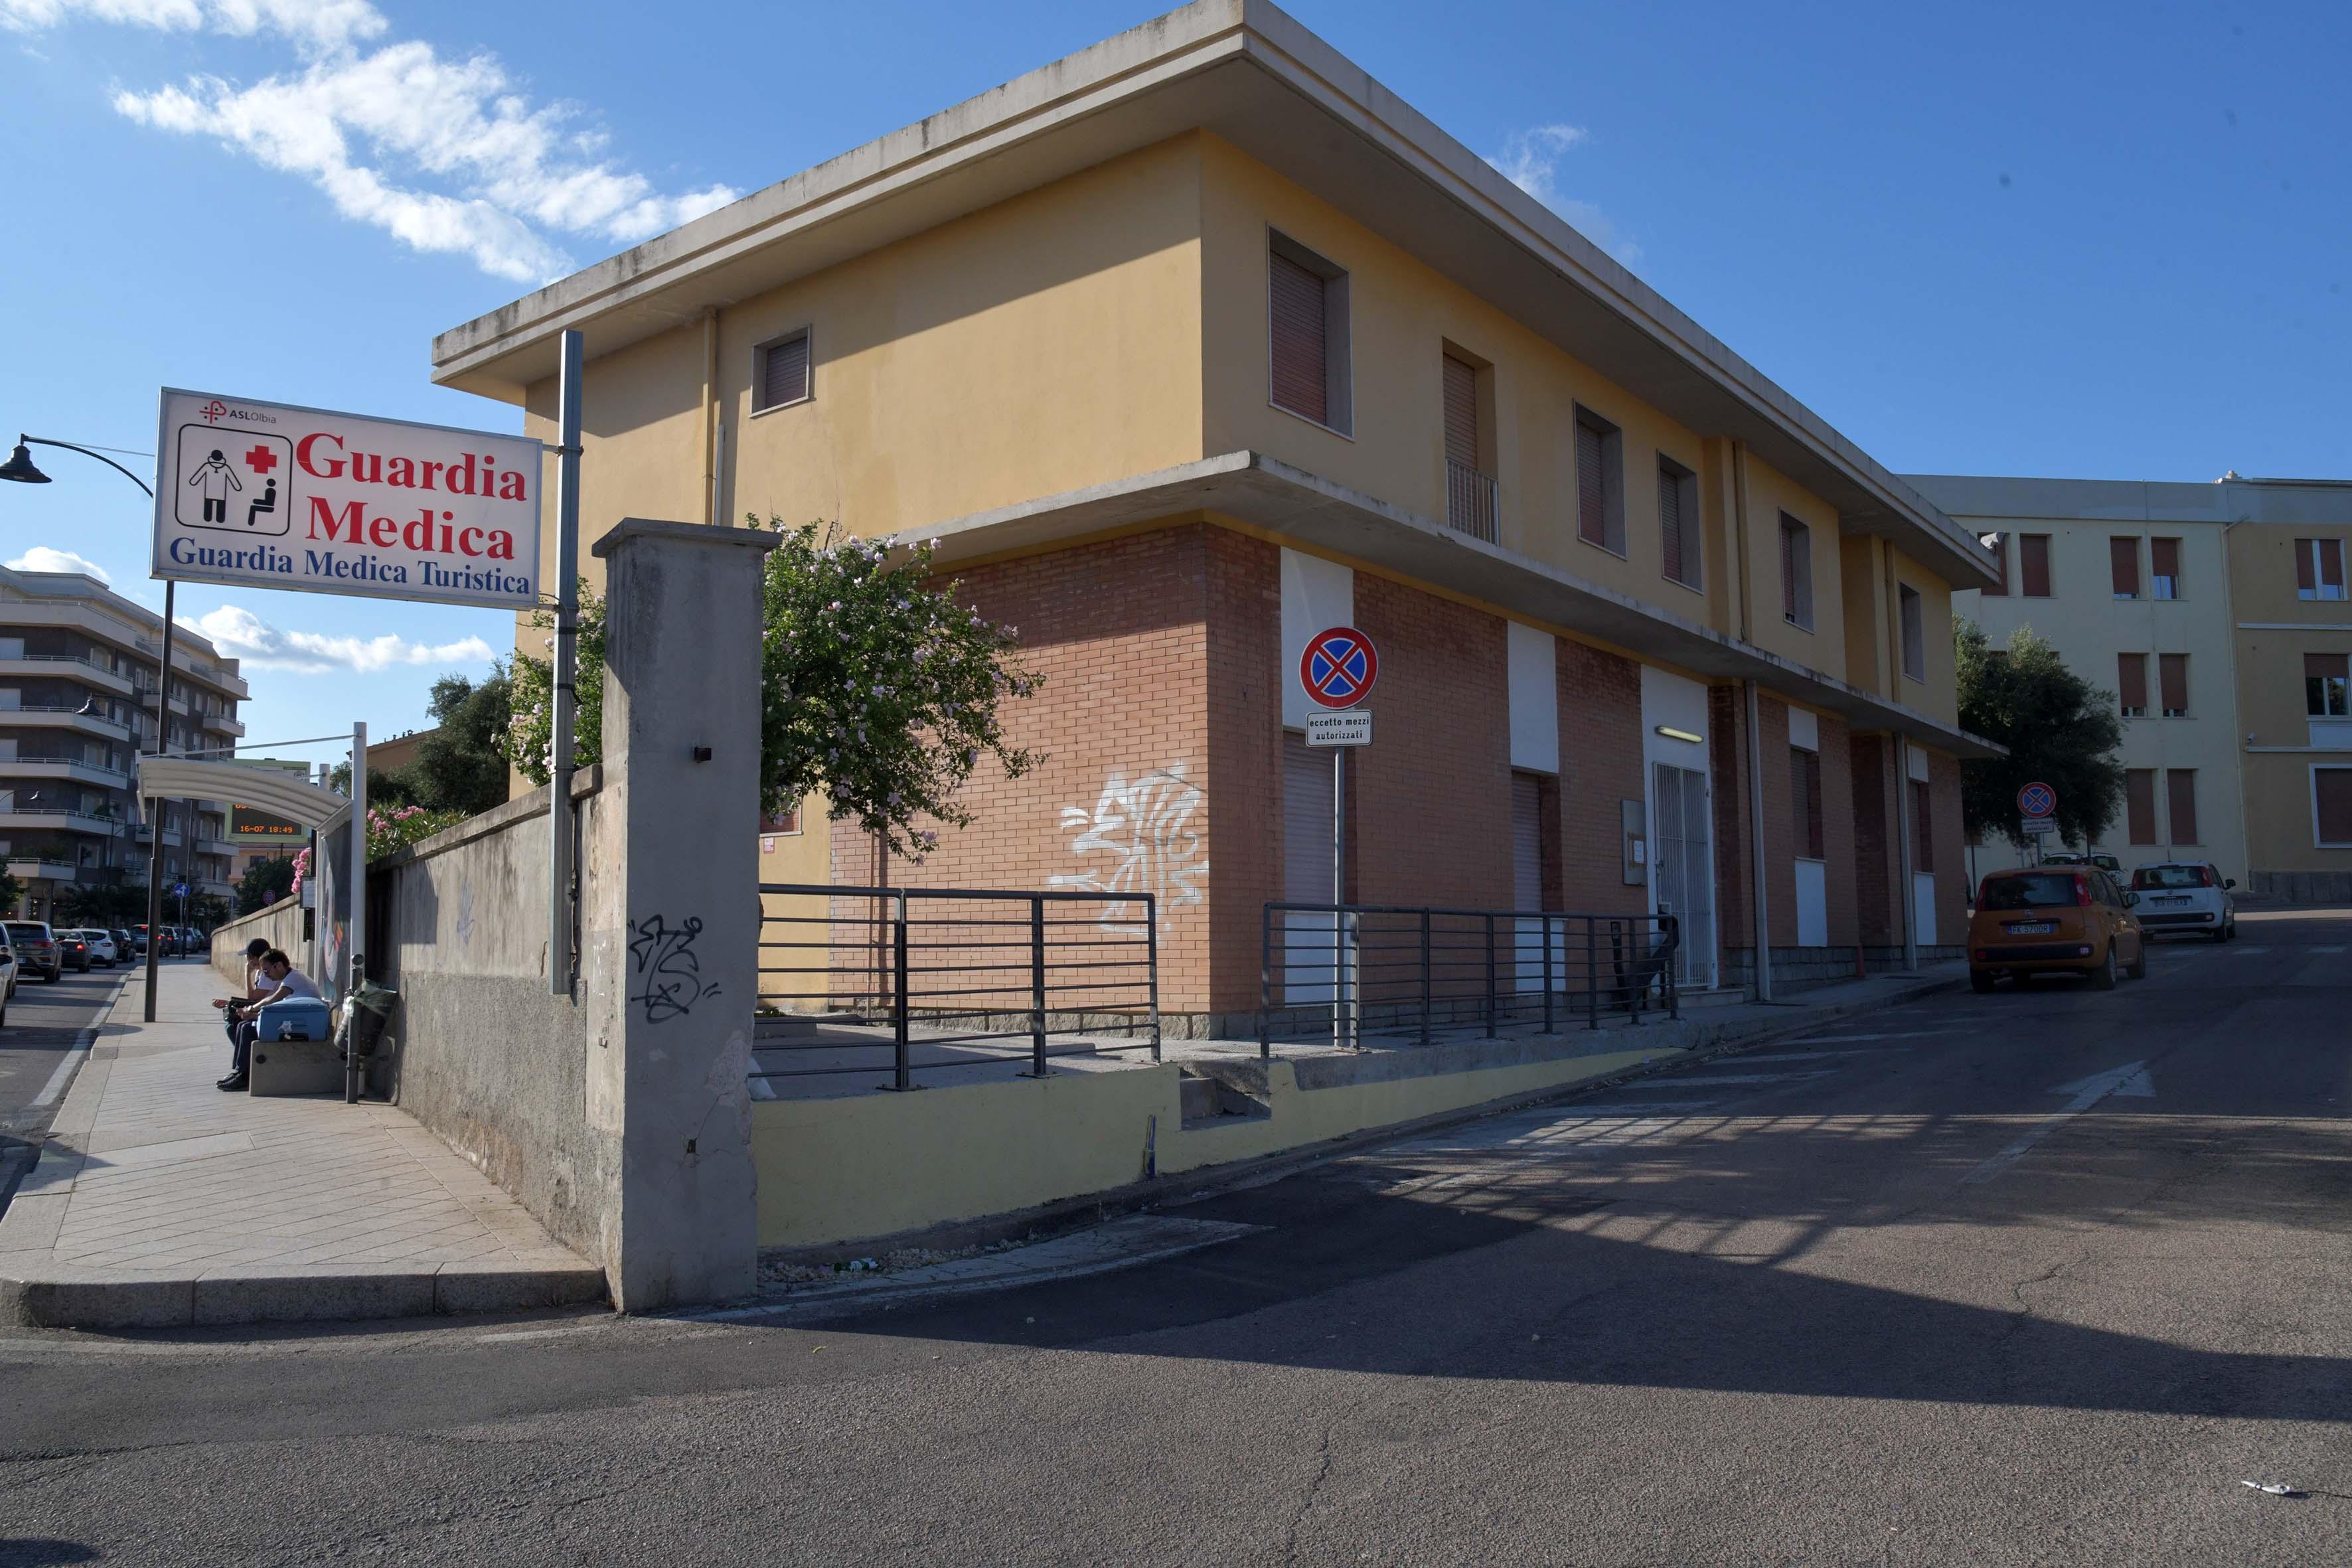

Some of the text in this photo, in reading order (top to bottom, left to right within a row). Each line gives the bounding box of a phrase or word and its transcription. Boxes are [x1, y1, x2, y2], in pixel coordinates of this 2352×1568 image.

[228, 409, 277, 424] ASLOlbia
[296, 432, 527, 501] Guardia
[305, 495, 515, 560] Medica
[169, 536, 530, 595] Guardia Medica Turistica
[1310, 716, 1369, 727] eccetto mezzi
[1316, 730, 1362, 740] autorizzati
